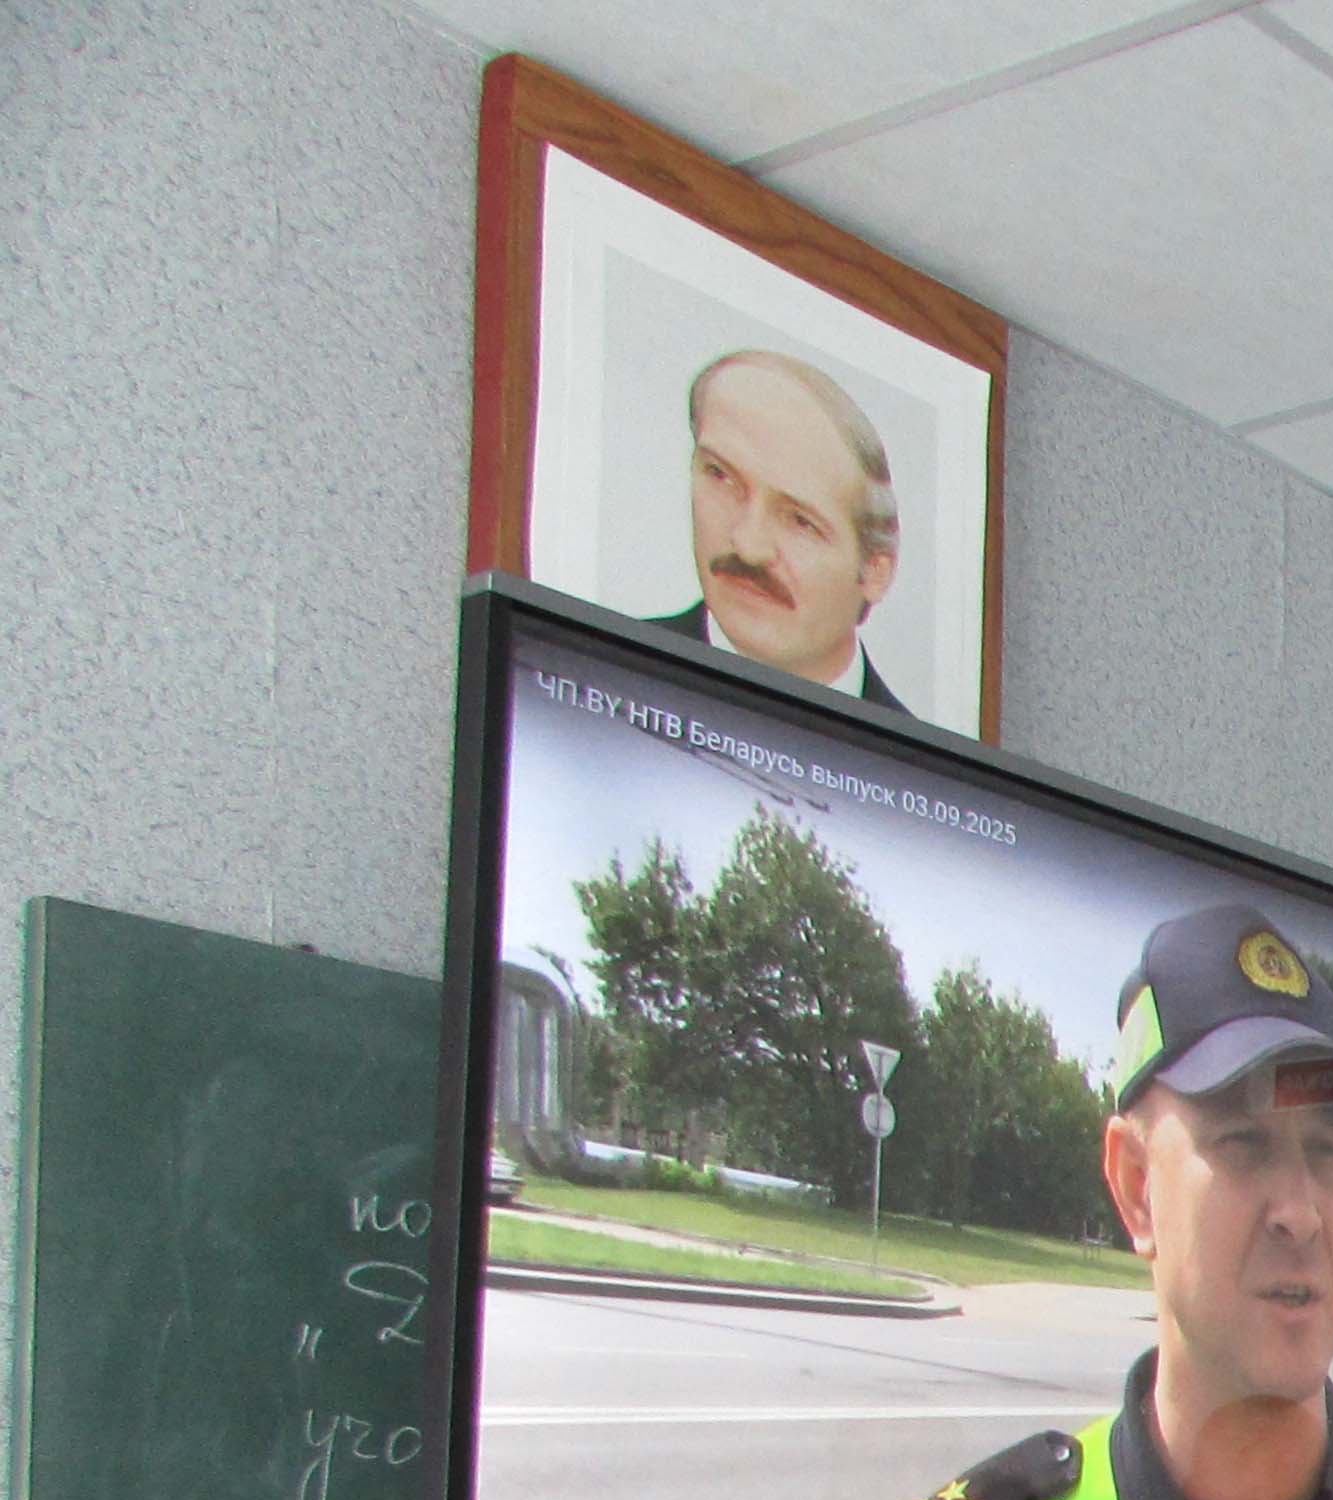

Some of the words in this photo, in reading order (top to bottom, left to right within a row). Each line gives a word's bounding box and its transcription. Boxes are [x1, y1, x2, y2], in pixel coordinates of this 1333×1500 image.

[629, 701, 682, 738] НТВ
[689, 721, 806, 778] Беларусь
[812, 764, 897, 809] выпуск
[902, 791, 1017, 846] 03.09.2025
